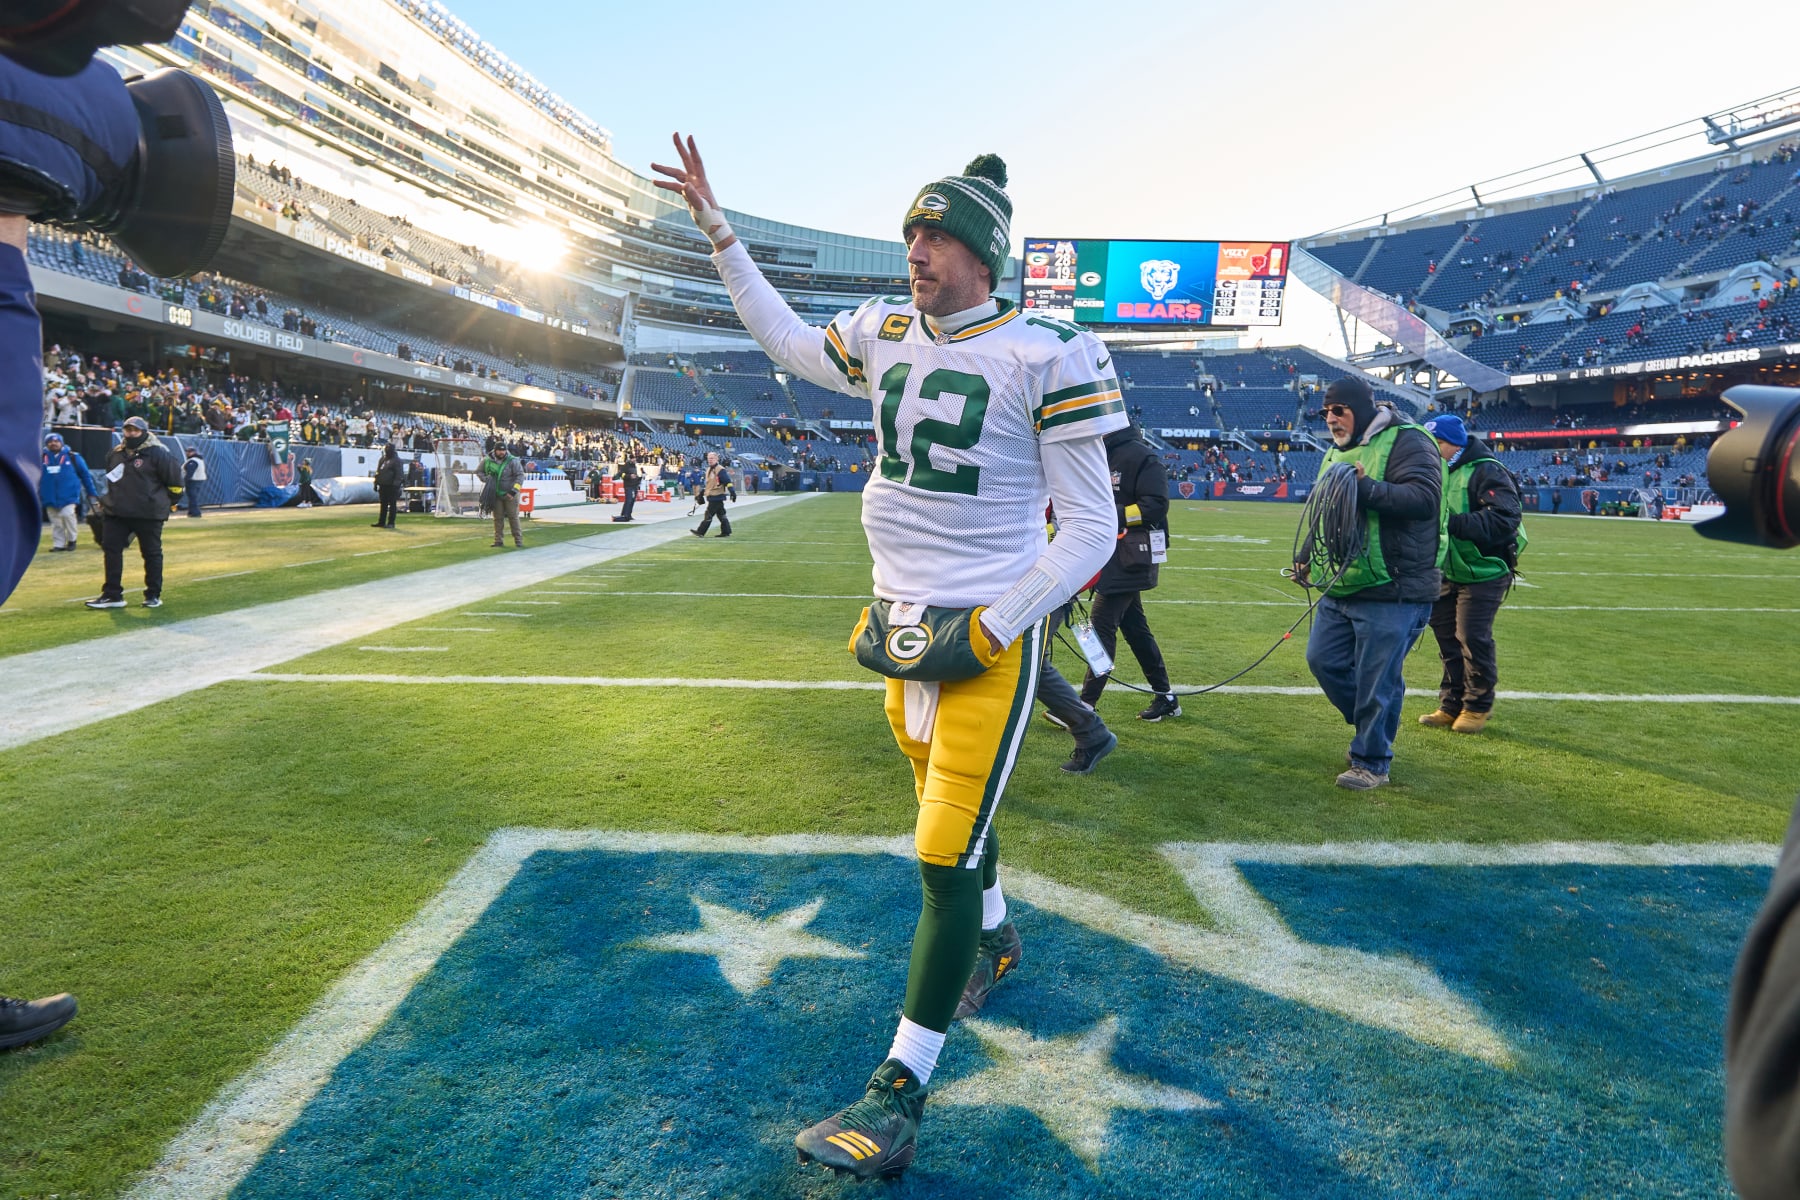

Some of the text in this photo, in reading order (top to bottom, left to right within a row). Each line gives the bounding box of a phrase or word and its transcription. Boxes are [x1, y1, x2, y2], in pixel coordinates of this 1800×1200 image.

[326, 236, 387, 271] PACKERS
[1054, 253, 1071, 267] 28
[1222, 248, 1250, 257] VIZZY
[1055, 267, 1070, 280] 19
[1073, 300, 1105, 308] PACKERS
[1117, 302, 1202, 318] BEARS
[883, 314, 910, 334] C
[223, 321, 304, 351] SOLDIER FIELD
[1679, 348, 1761, 368] PACKERS
[830, 420, 874, 430] BEAR
[879, 362, 991, 496] 12
[1161, 429, 1211, 438] DOWN
[888, 625, 930, 660] G
